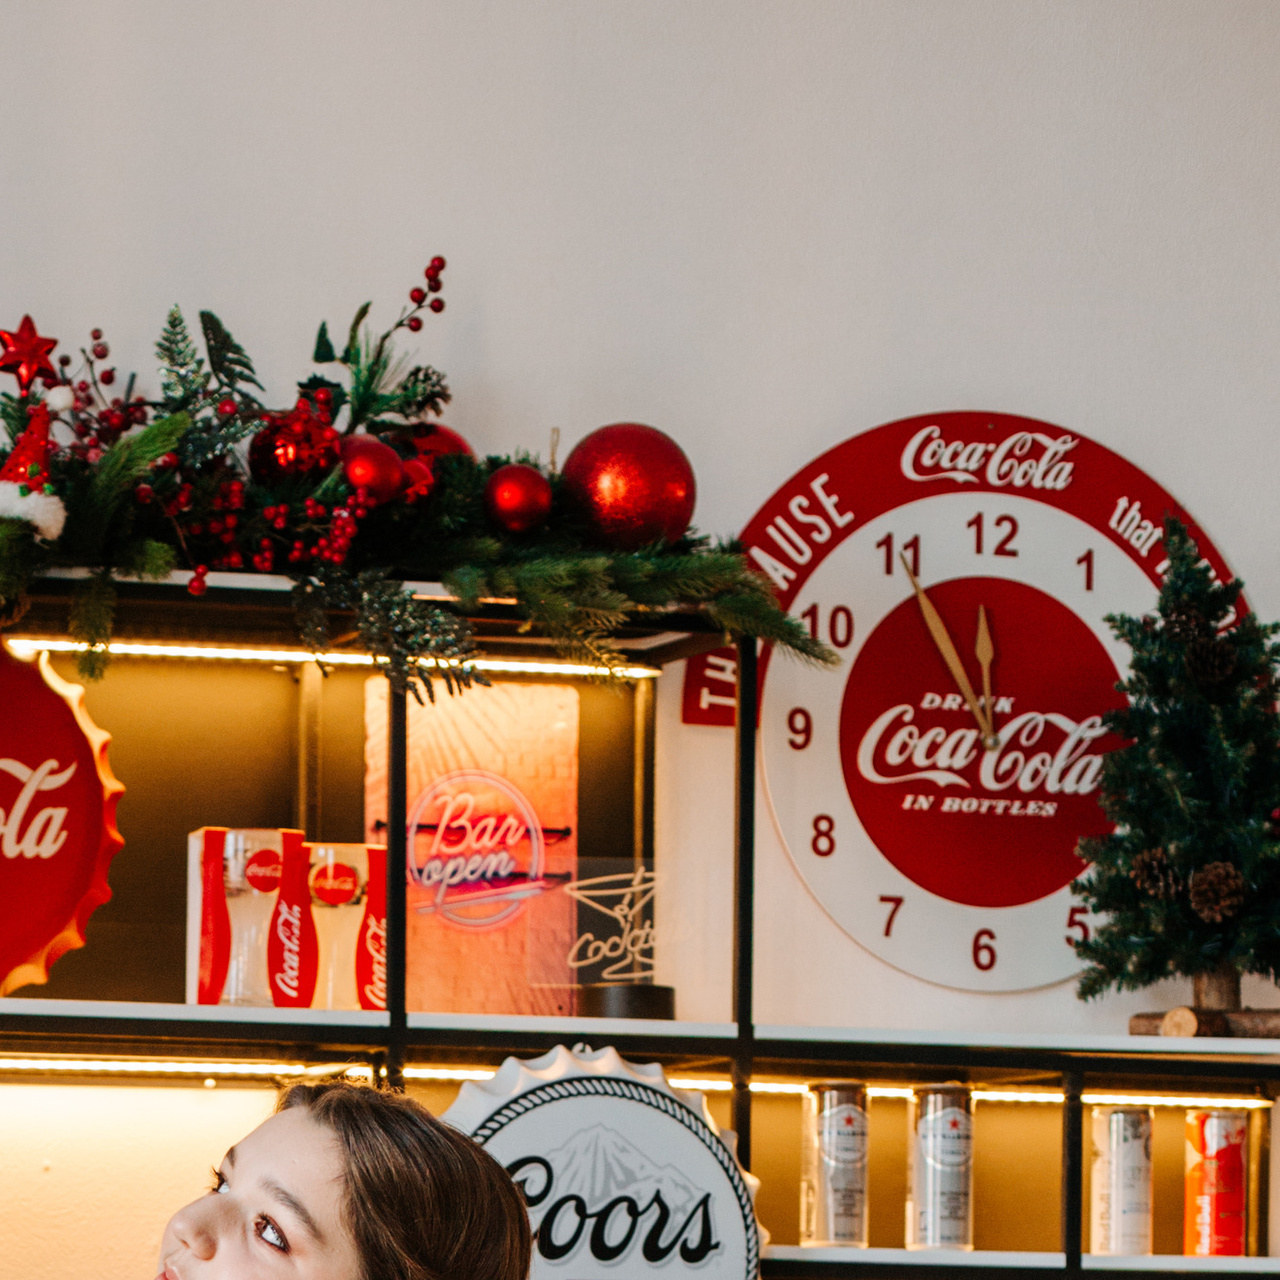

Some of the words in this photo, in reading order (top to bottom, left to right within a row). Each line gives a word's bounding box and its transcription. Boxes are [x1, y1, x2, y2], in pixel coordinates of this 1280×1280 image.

[901, 425, 1080, 491] Coca-Cola
[966, 512, 1020, 557] 12
[1108, 496, 1164, 558] that
[876, 532, 921, 577] 11
[1076, 548, 1096, 592] 1
[700, 654, 738, 710] TH
[749, 472, 855, 592] AUSE
[801, 603, 854, 648] 10
[787, 708, 813, 750] 9
[431, 792, 526, 855] Bar
[902, 795, 935, 812] IN
[941, 796, 1058, 817] BOTTLES
[811, 814, 836, 857] 8
[421, 850, 516, 904] open
[879, 896, 905, 938] 7
[1066, 907, 1090, 948] 5
[971, 929, 997, 972] 6
